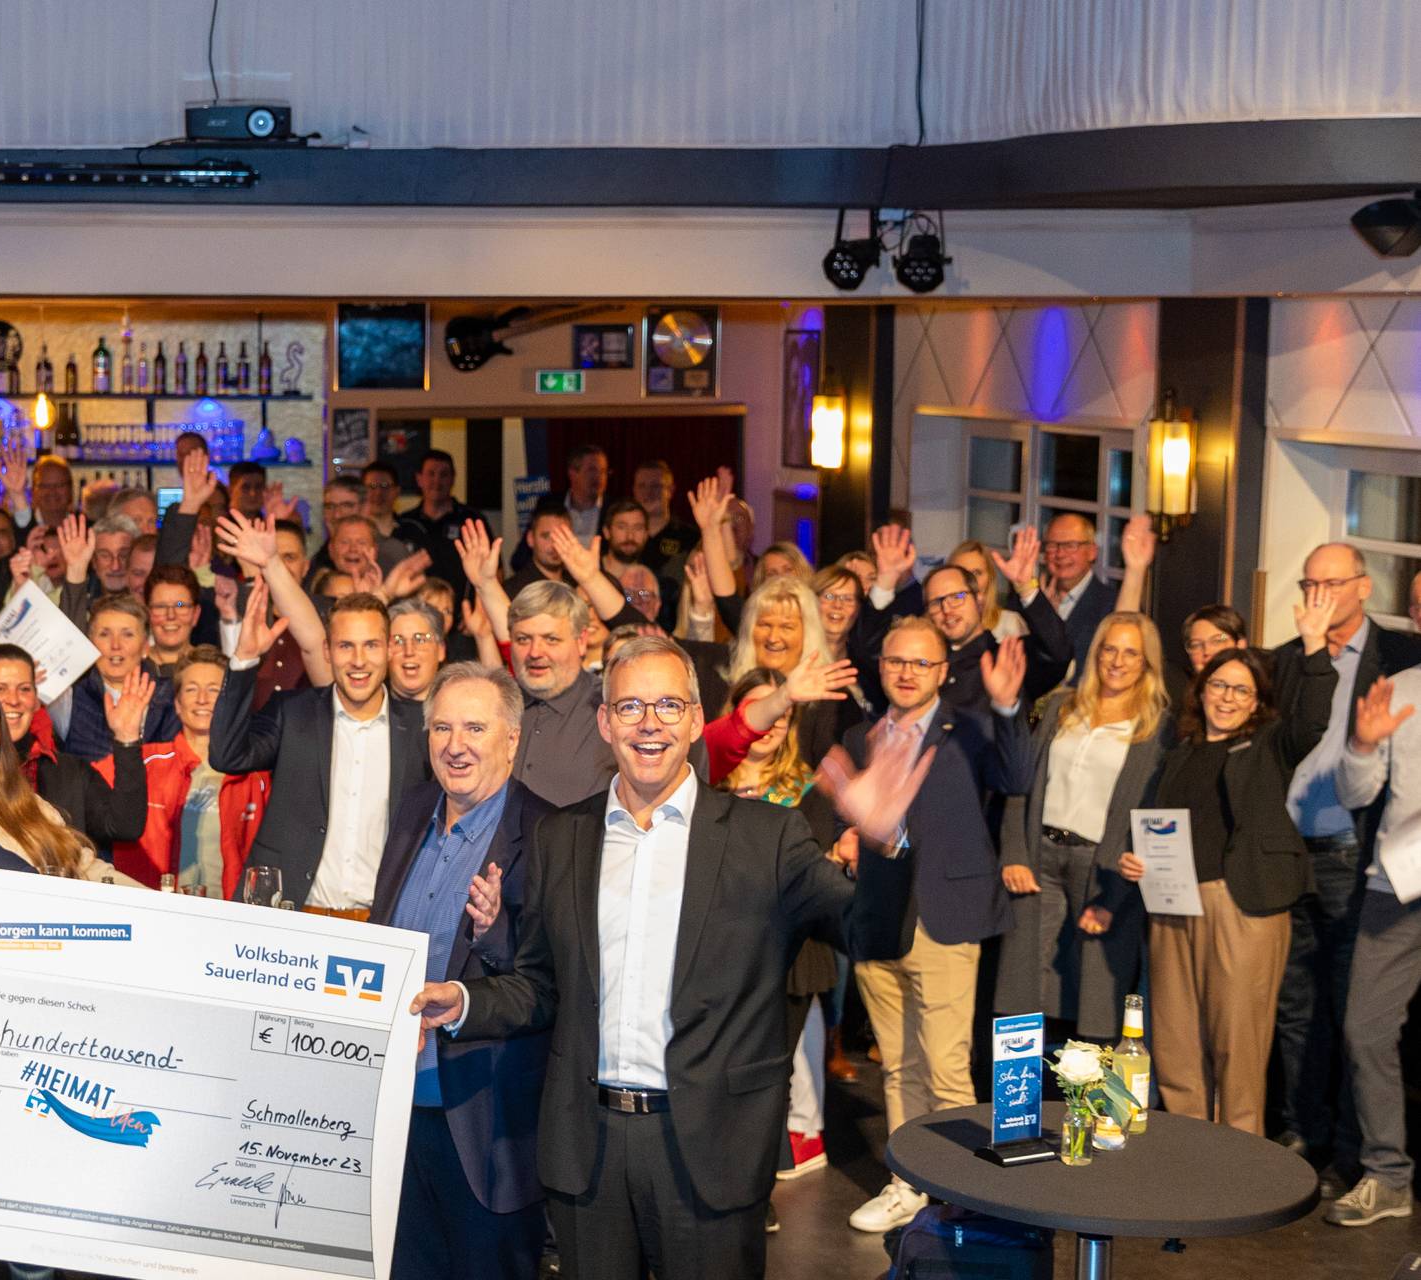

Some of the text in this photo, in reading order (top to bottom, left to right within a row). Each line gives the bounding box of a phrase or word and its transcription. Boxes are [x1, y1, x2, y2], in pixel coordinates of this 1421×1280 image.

[38, 925, 69, 937] kann
[72, 925, 129, 938] kommen.
[235, 944, 320, 970] Volksbank
[204, 962, 316, 991] Sauerland eG
[8, 994, 35, 1005] gegen
[37, 996, 65, 1008] diesen
[67, 1001, 96, 1013] Scheck
[293, 1019, 315, 1029] Betrag
[258, 1027, 274, 1044] €
[20, 1059, 116, 1110] #HEIMAT
[235, 1159, 257, 1169] Datum
[239, 1141, 362, 1173] 15. November 23
[230, 1198, 267, 1209] Unterschrift
